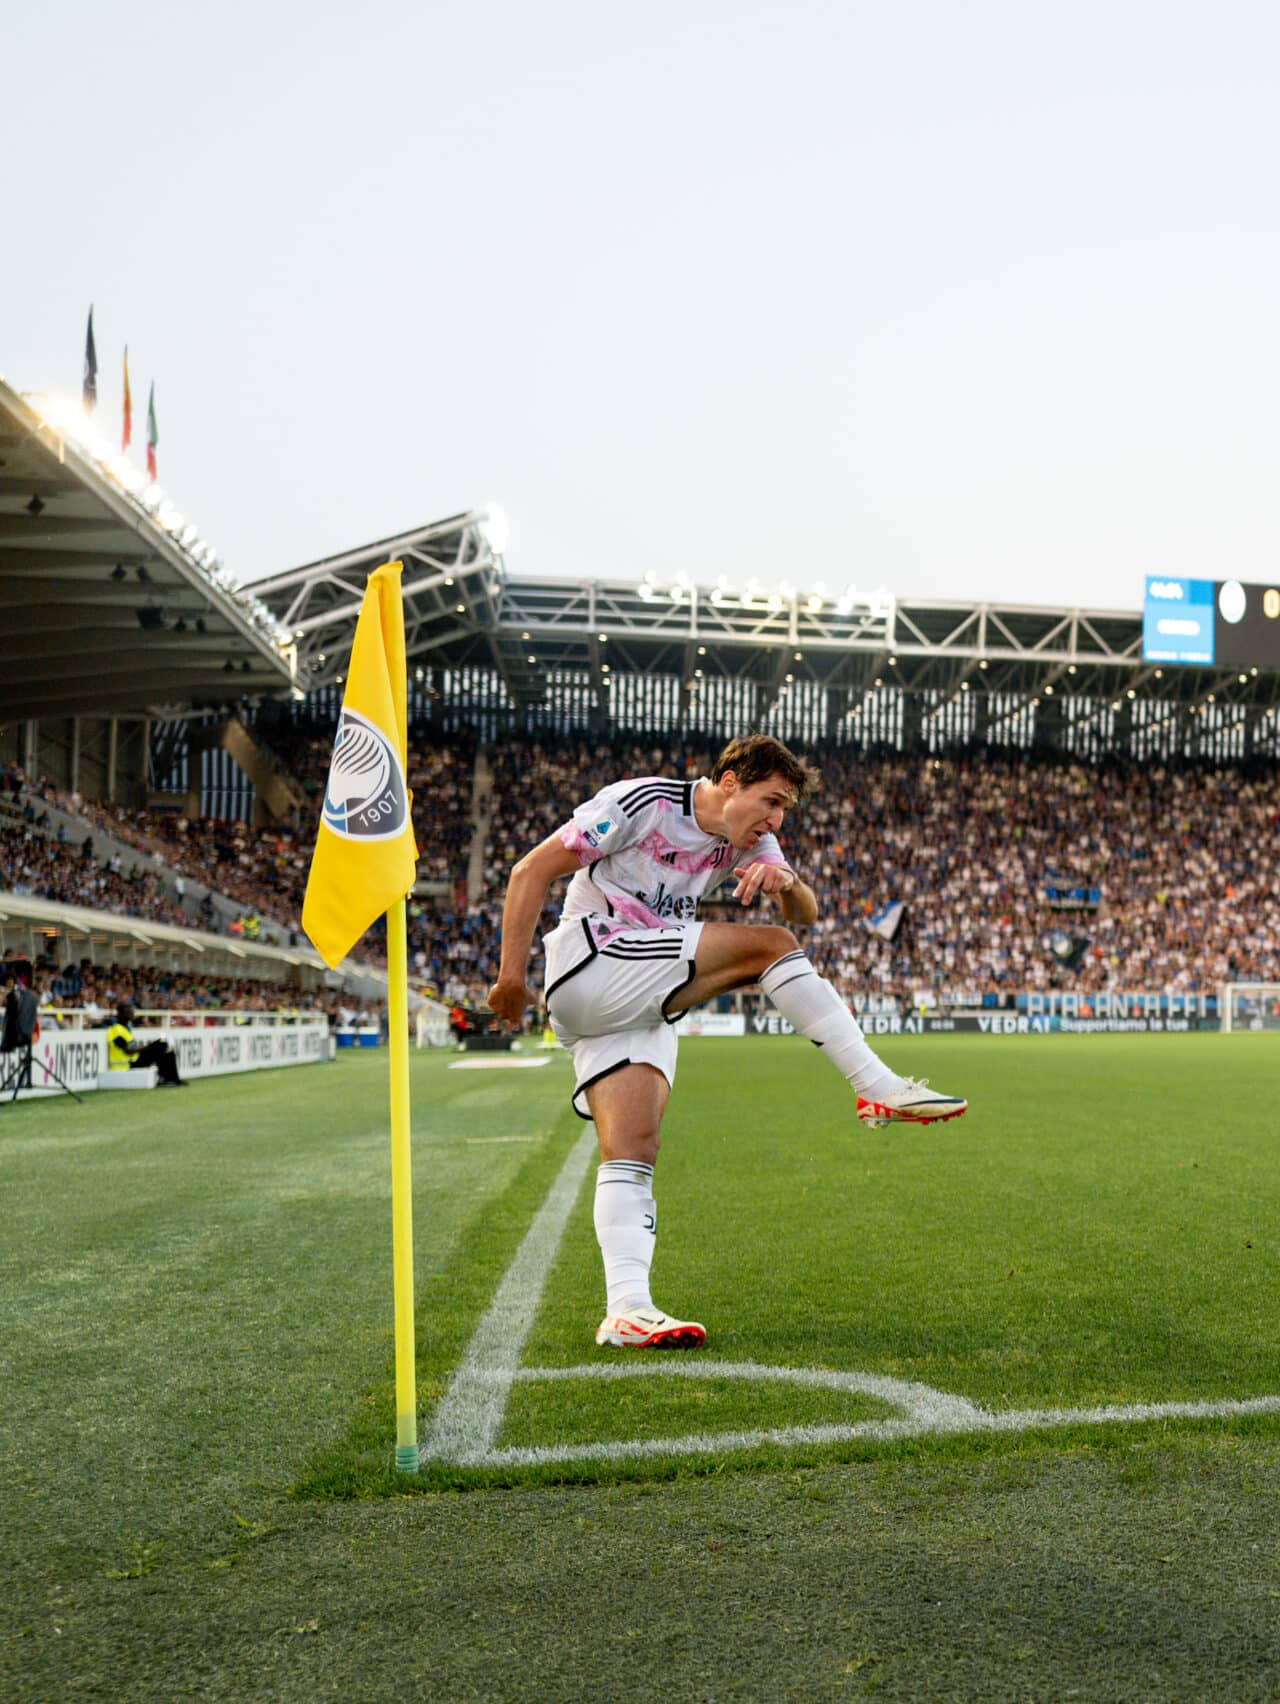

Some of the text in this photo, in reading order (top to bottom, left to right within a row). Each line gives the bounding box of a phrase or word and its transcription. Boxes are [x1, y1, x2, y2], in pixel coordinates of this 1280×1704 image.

[359, 790, 399, 827] 1907
[977, 1016, 1050, 1034] VEDRAI
[55, 1042, 98, 1080] INTRED
